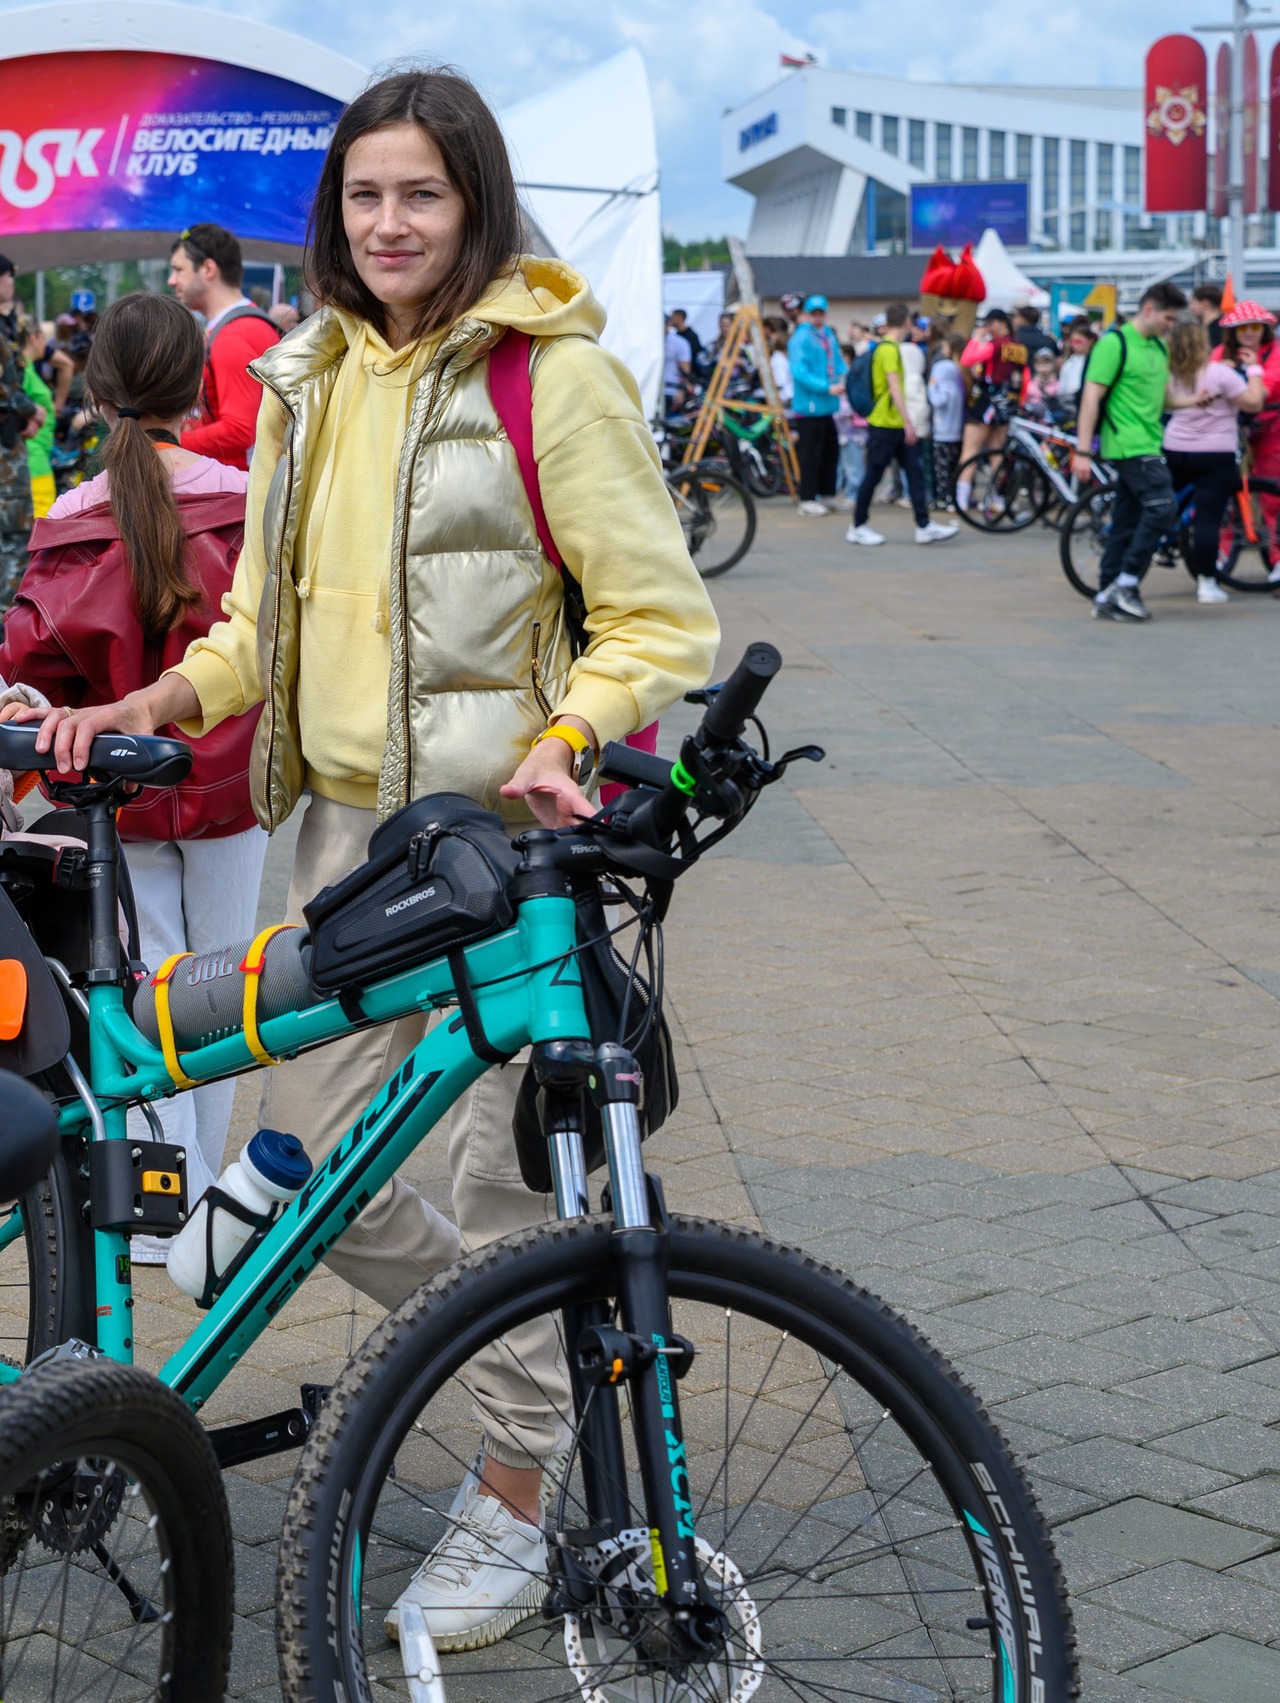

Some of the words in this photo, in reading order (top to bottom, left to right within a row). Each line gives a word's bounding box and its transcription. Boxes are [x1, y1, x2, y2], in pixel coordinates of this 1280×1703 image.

[125, 152, 198, 177] КЛУБ
[385, 886, 436, 917] ROCKBROS
[187, 947, 233, 987] JBL
[298, 1053, 417, 1219] FUJI
[119, 1257, 131, 1271] 19
[265, 1190, 371, 1317] FUJI
[656, 1356, 672, 1402] SUNTOUR
[664, 1429, 695, 1540] XCM
[326, 1488, 352, 1658] SMART
